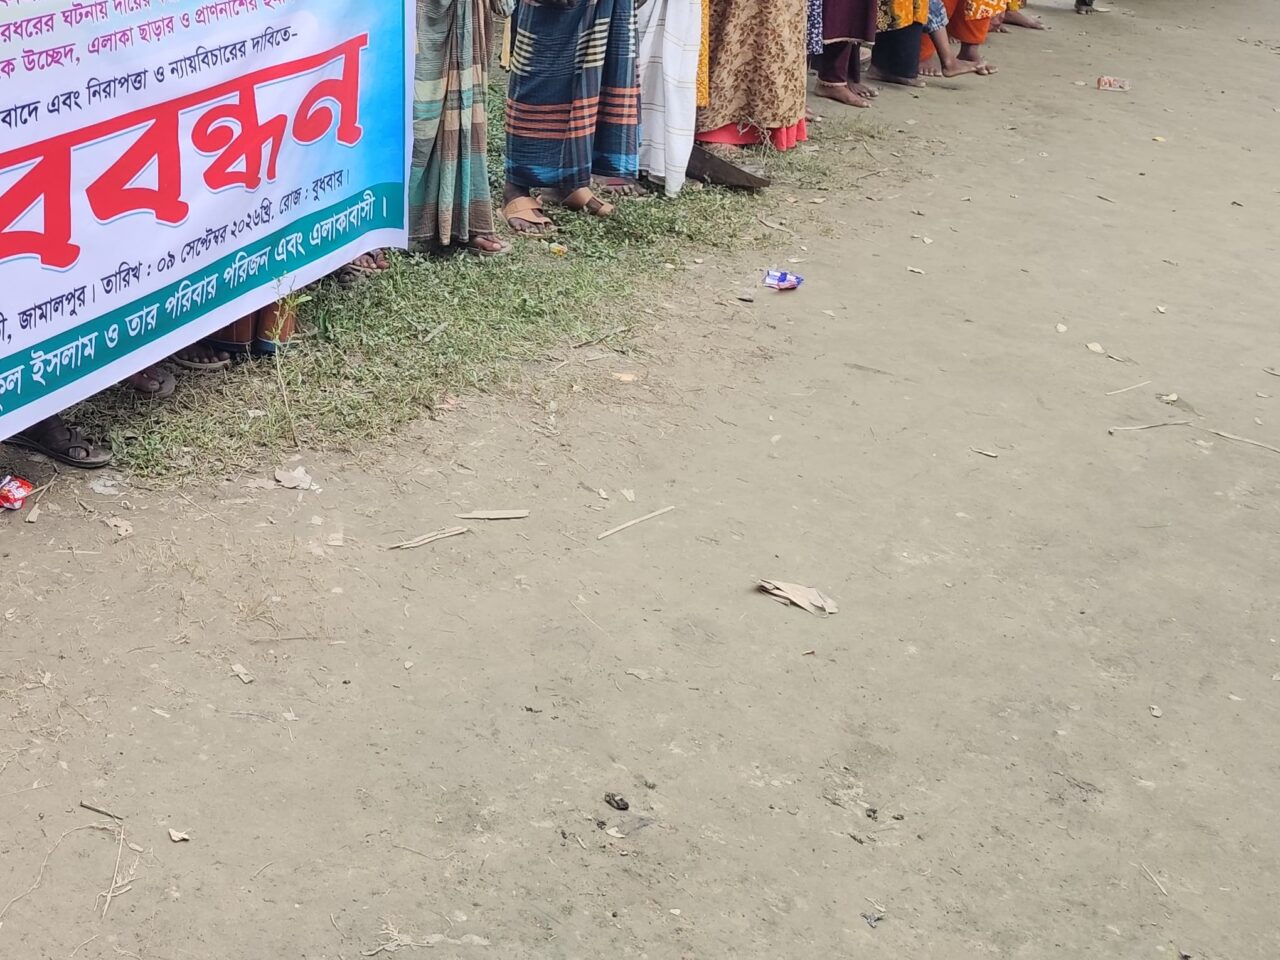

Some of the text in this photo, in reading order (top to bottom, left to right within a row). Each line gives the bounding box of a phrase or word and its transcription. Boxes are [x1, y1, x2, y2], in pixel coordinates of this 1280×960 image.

[21, 42, 80, 70] উচ্ছেদ,
[87, 27, 134, 55] এলাকা
[137, 15, 174, 42] ছাড়ার
[179, 12, 190, 28] ও
[61, 0, 108, 28] ঘটনায়
[47, 91, 82, 115] এবং
[86, 67, 148, 105] নিরাপত্তা
[153, 66, 165, 84] ও
[168, 40, 247, 80] ন্যায়বিচারের
[251, 25, 298, 53] দাবিতে-
[101, 261, 143, 294] তারিখ
[157, 251, 176, 273] ০৯
[181, 224, 229, 264] সেপ্টেম্বর
[279, 187, 303, 214] রোজ
[30, 331, 98, 385] ইসলাম
[104, 321, 119, 347] ও
[125, 302, 160, 337] তার
[164, 272, 219, 320] পরিবার
[224, 247, 271, 288] পরিজন
[274, 232, 306, 262] এবং
[309, 190, 376, 247] এলাকাবাসী
